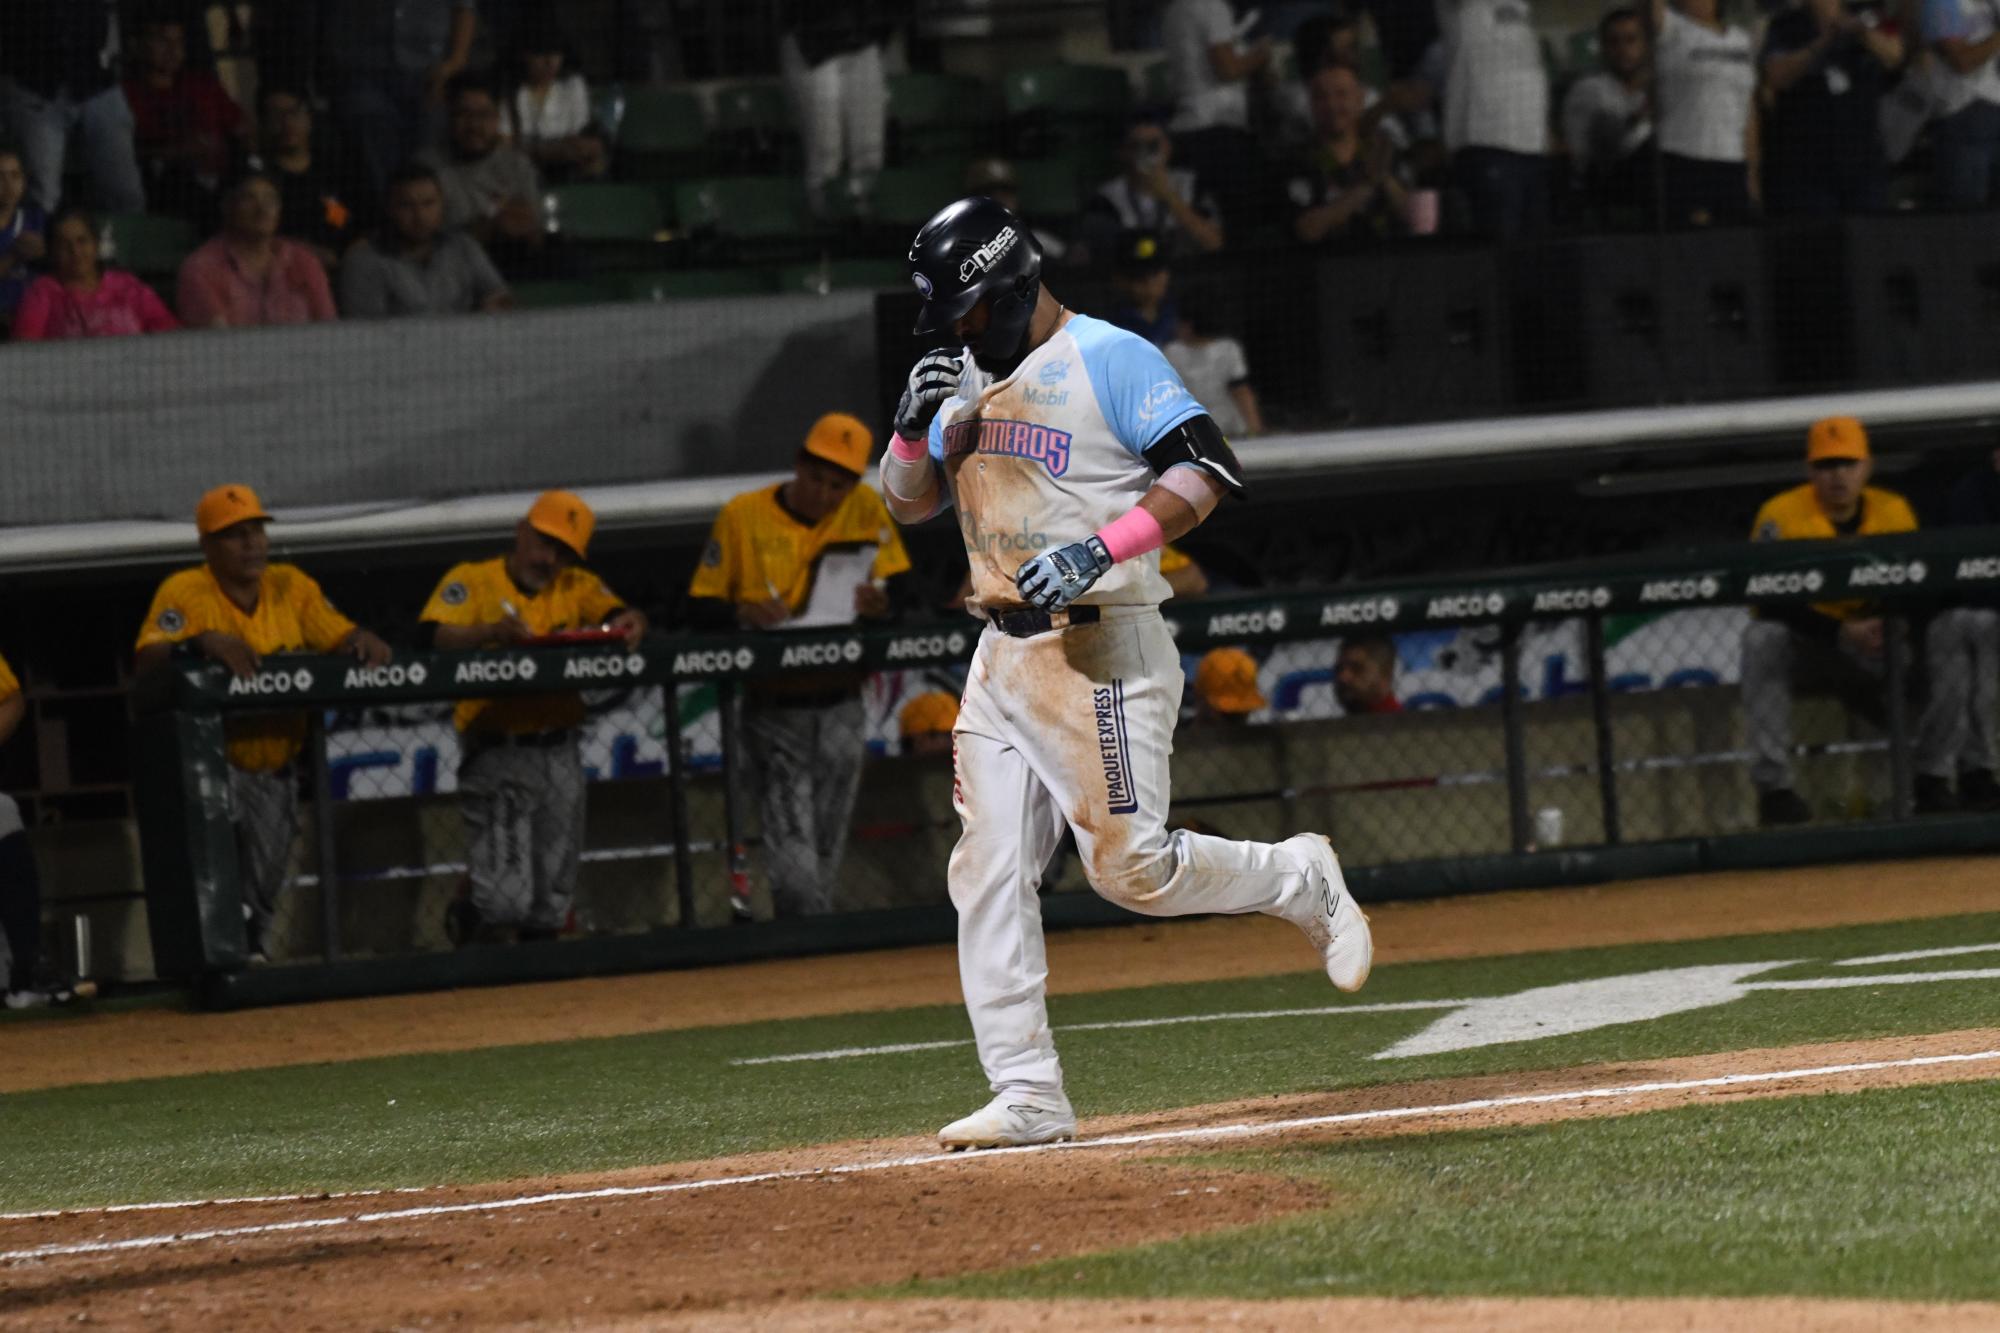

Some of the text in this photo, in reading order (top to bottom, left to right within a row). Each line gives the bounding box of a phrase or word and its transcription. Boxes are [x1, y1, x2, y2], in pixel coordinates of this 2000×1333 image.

[1023, 387, 1070, 406] Mobil
[456, 660, 516, 684] ARCO
[564, 654, 625, 679] ARCO
[674, 650, 732, 675] ARCO
[782, 643, 840, 668] ARCO
[887, 636, 945, 661] ARCO
[1208, 613, 1266, 638] ARCO
[1321, 601, 1379, 626] ARCO
[1426, 595, 1484, 620] ARCO
[1534, 589, 1591, 613] ARCO
[1639, 580, 1697, 602] ARCO
[1745, 573, 1801, 596] ARCO
[1849, 565, 1907, 587] ARCO
[1956, 555, 2000, 580] ARC
[1094, 687, 1125, 800] PAQUETEXPRESS
